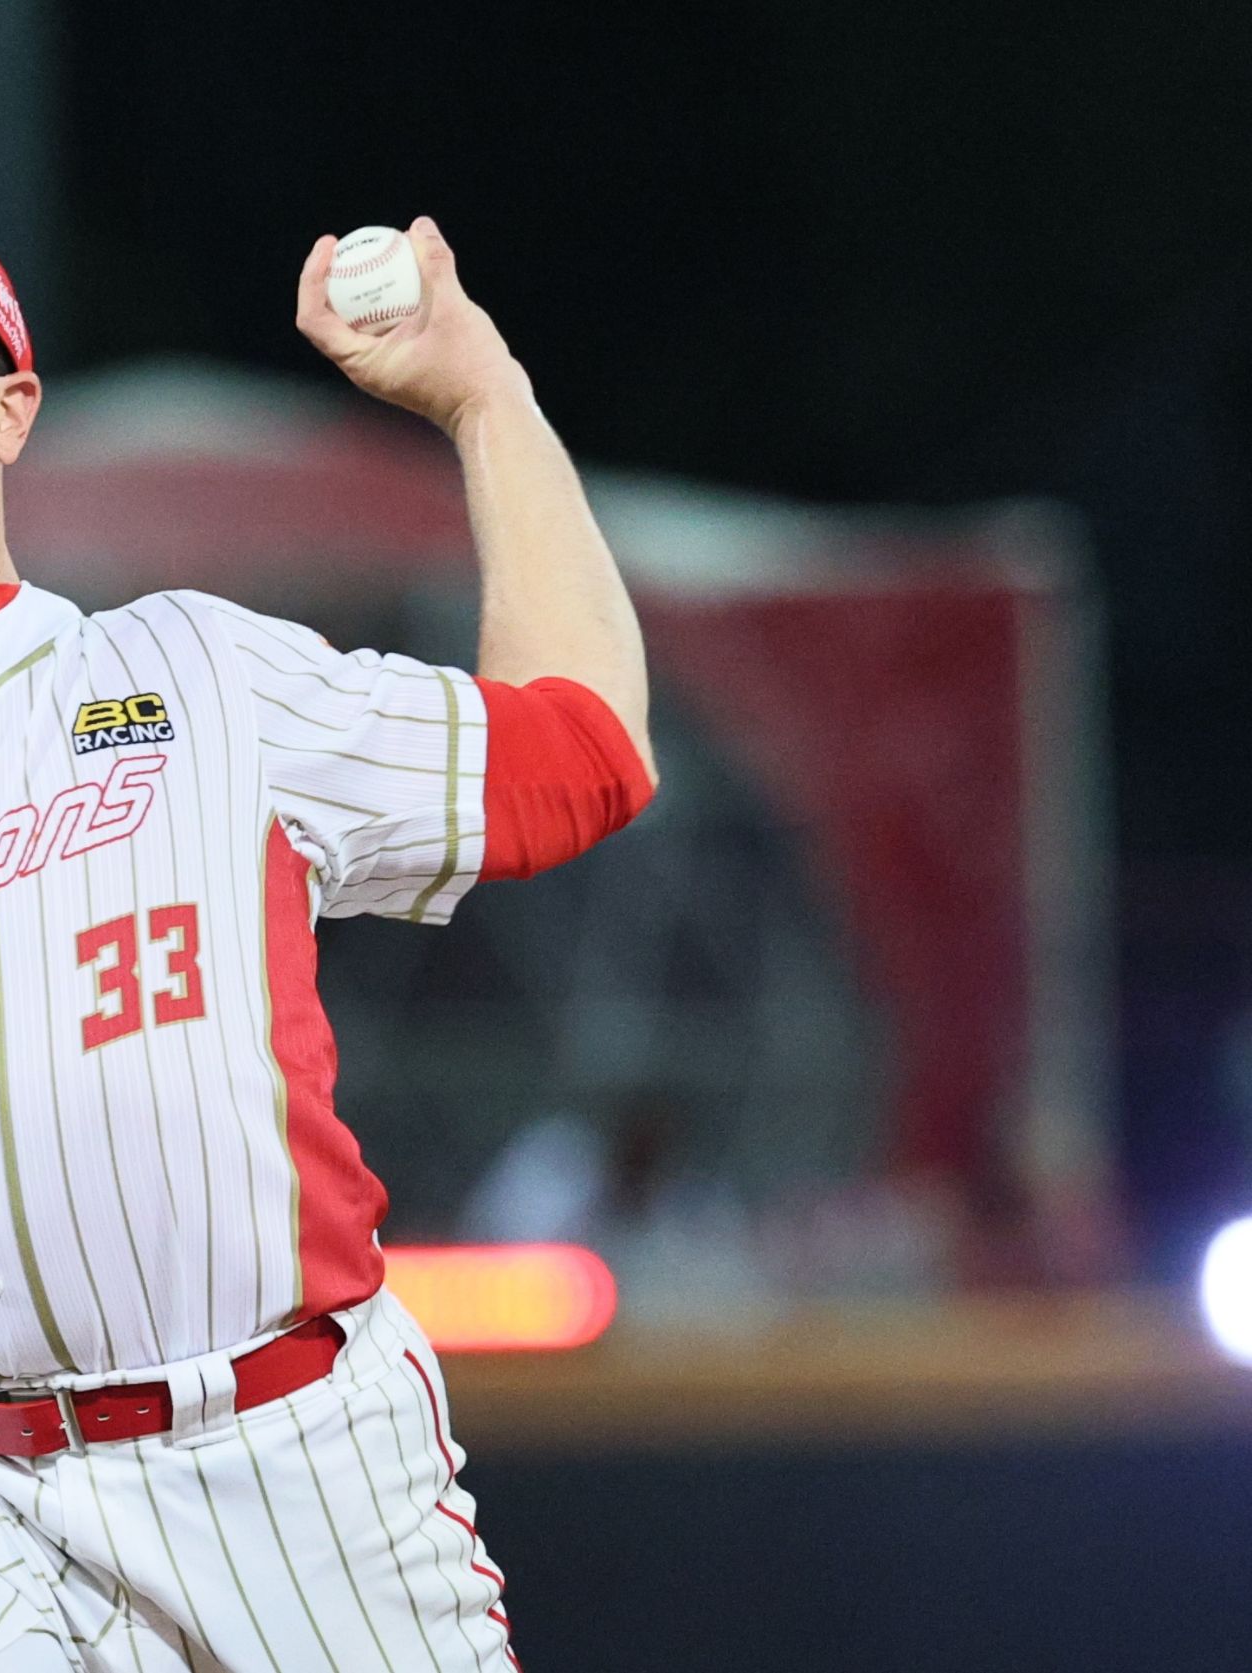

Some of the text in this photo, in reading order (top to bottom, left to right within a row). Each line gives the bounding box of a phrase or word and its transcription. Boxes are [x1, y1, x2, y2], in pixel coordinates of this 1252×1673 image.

[74, 694, 166, 734] BC
[74, 722, 173, 753] RACING
[76, 902, 207, 1055] 33
